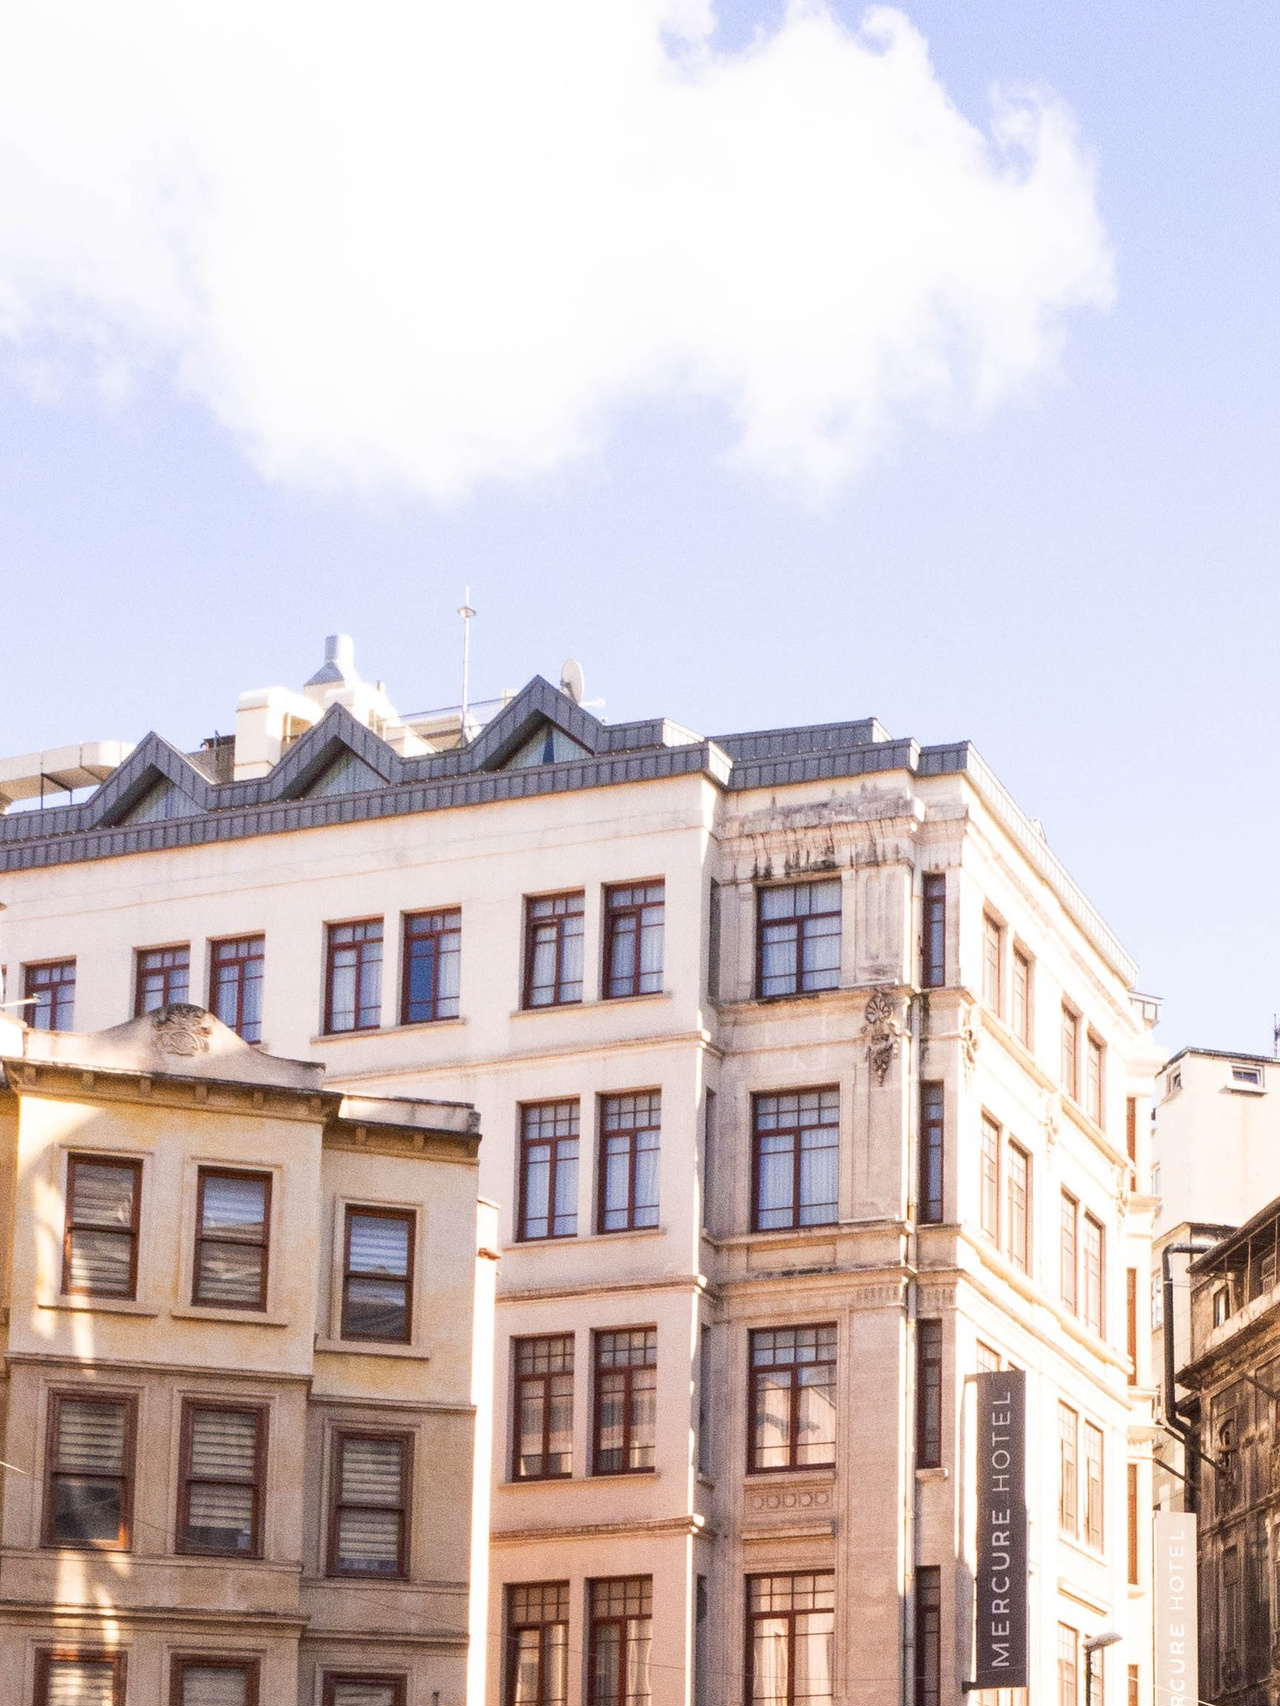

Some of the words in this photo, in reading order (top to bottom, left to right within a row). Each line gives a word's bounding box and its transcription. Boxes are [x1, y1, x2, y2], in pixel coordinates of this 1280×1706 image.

[991, 1390, 1011, 1493] HOTEL
[991, 1511, 1011, 1668] MERCURE
[1169, 1530, 1186, 1611] HOTEL
